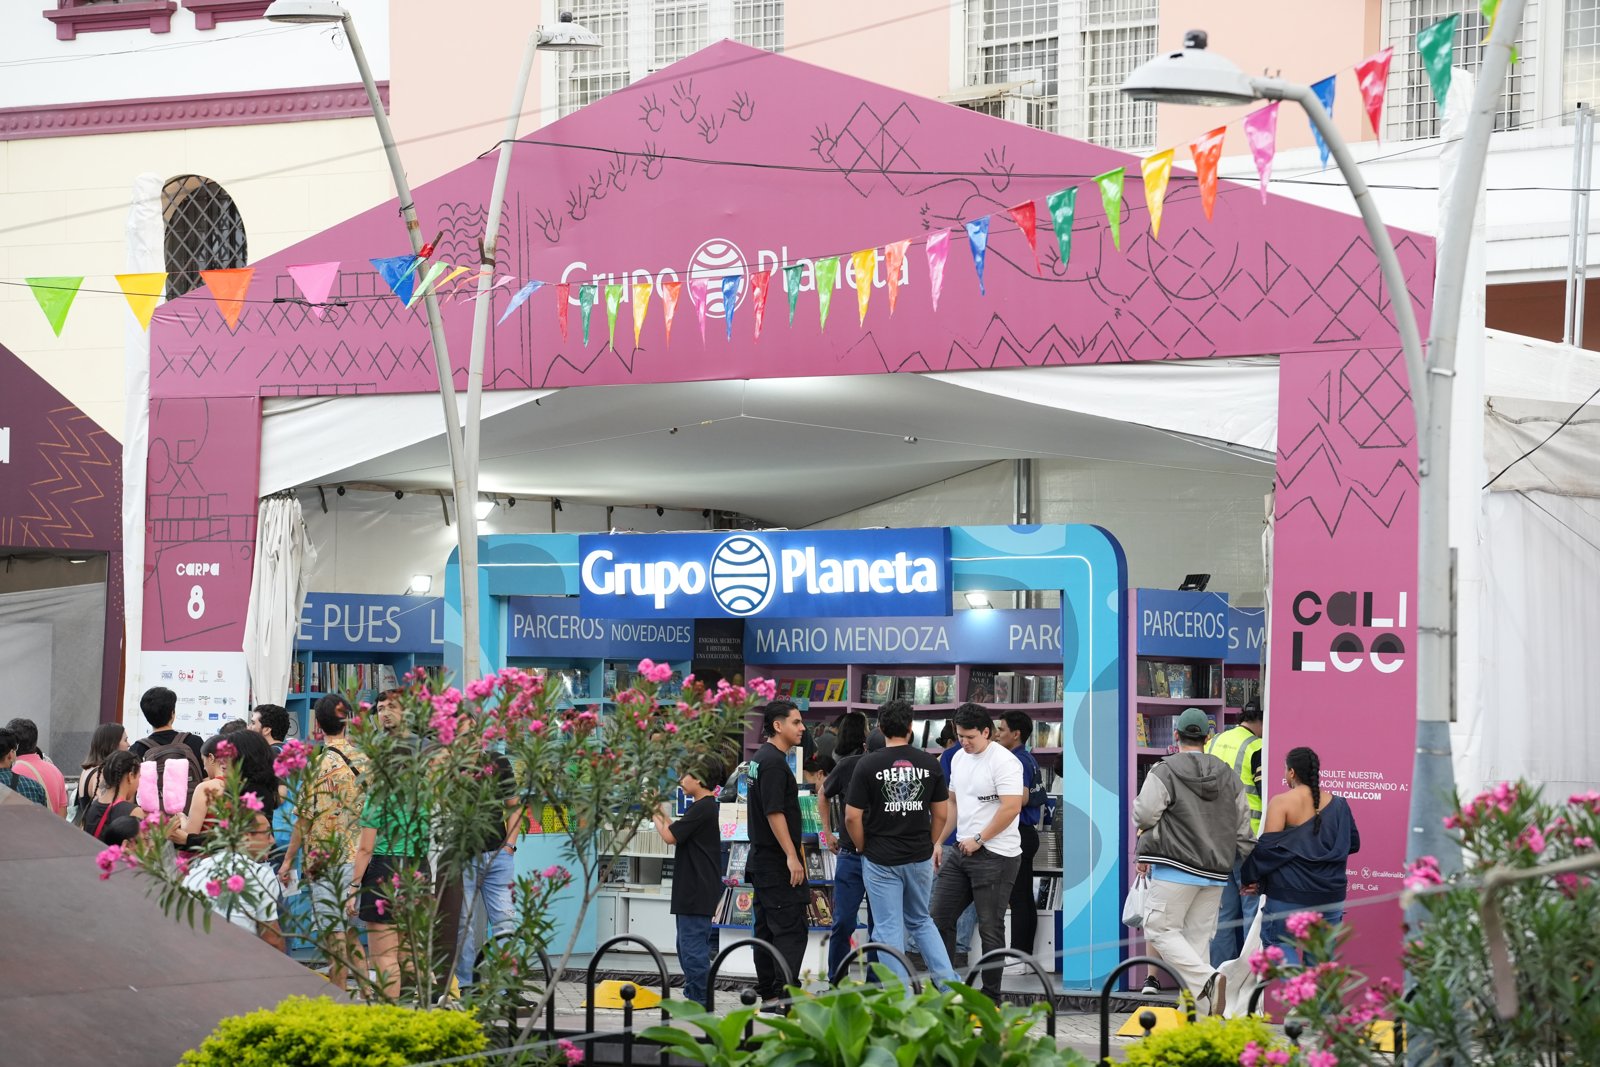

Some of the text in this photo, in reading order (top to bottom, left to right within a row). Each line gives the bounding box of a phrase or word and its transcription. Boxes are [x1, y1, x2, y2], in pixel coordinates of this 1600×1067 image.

[581, 546, 938, 609] Grupo Planeta
[187, 585, 205, 620] 8
[323, 603, 402, 643] PUES
[513, 614, 605, 640] PARCEROS
[611, 623, 691, 643] NOVEDADES
[1143, 610, 1225, 639] PARCEROS
[756, 625, 950, 653] MARIO MENDOZA
[875, 766, 930, 782] CREATIVE
[1318, 769, 1384, 780] NSULTE NUESTRA
[1346, 780, 1398, 791] INGRESANDO
[884, 800, 923, 812] ZOO YORK
